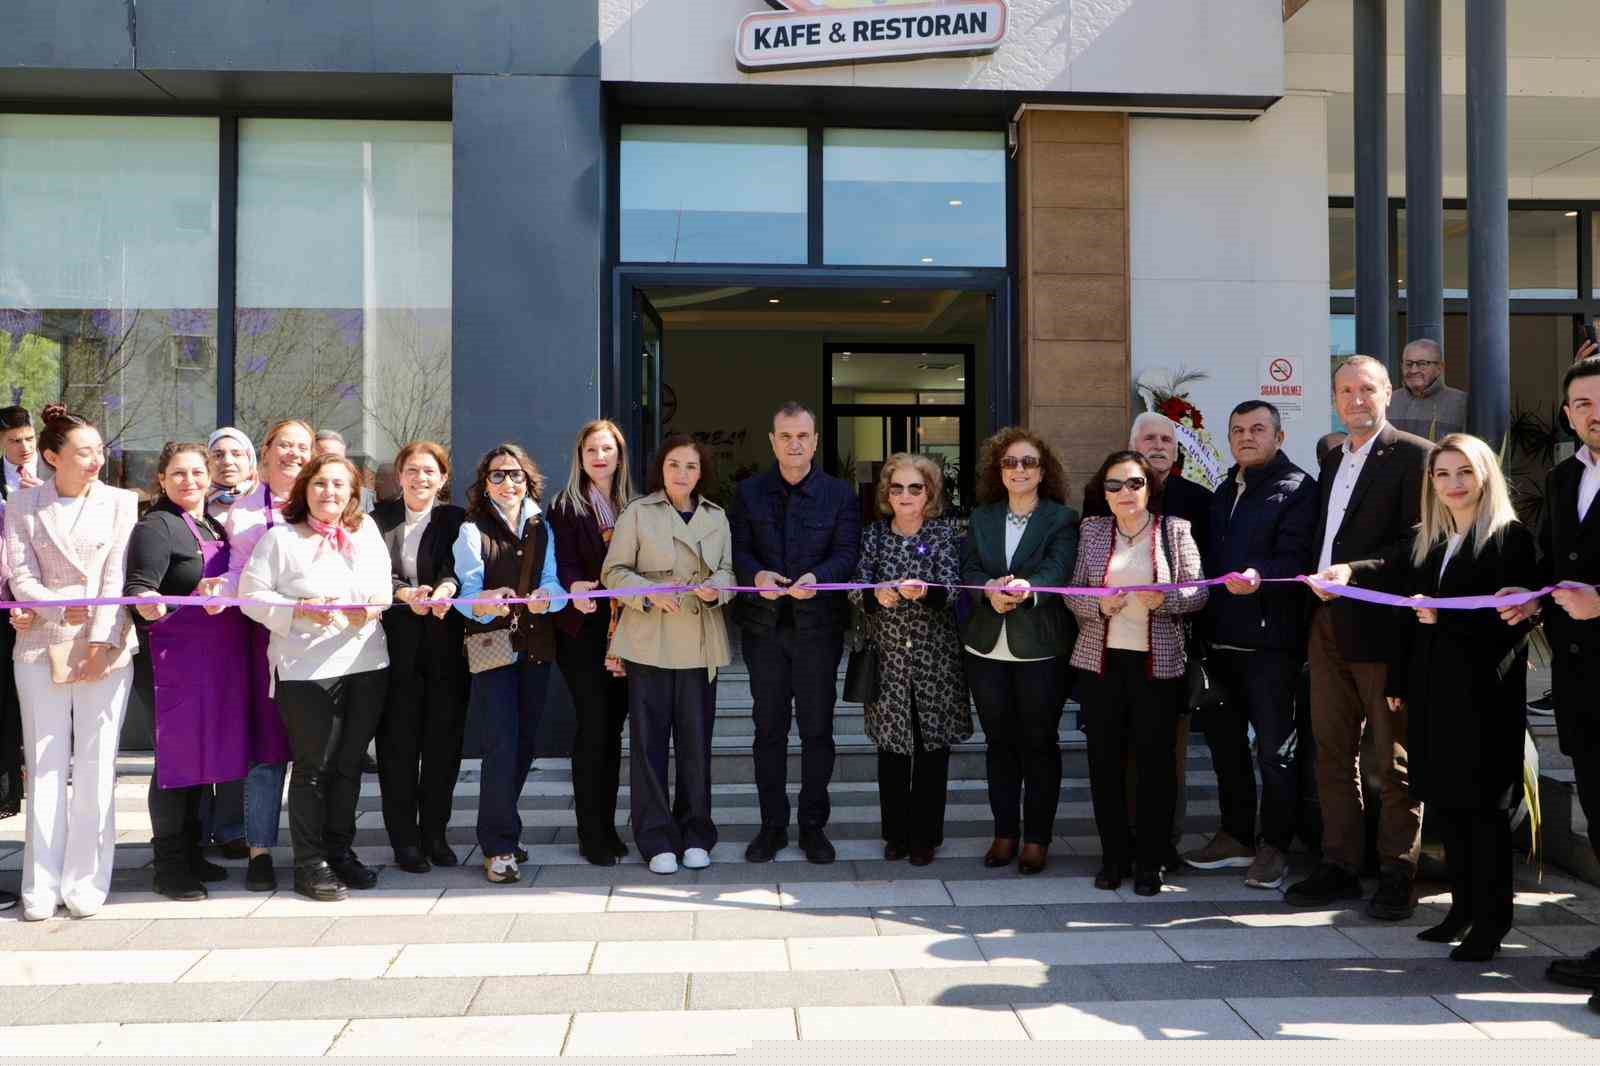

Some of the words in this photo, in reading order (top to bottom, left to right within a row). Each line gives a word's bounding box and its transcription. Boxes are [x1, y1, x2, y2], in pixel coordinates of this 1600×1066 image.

[754, 23, 821, 50] KAFE
[829, 22, 846, 43] &
[853, 11, 987, 42] RESTORAN
